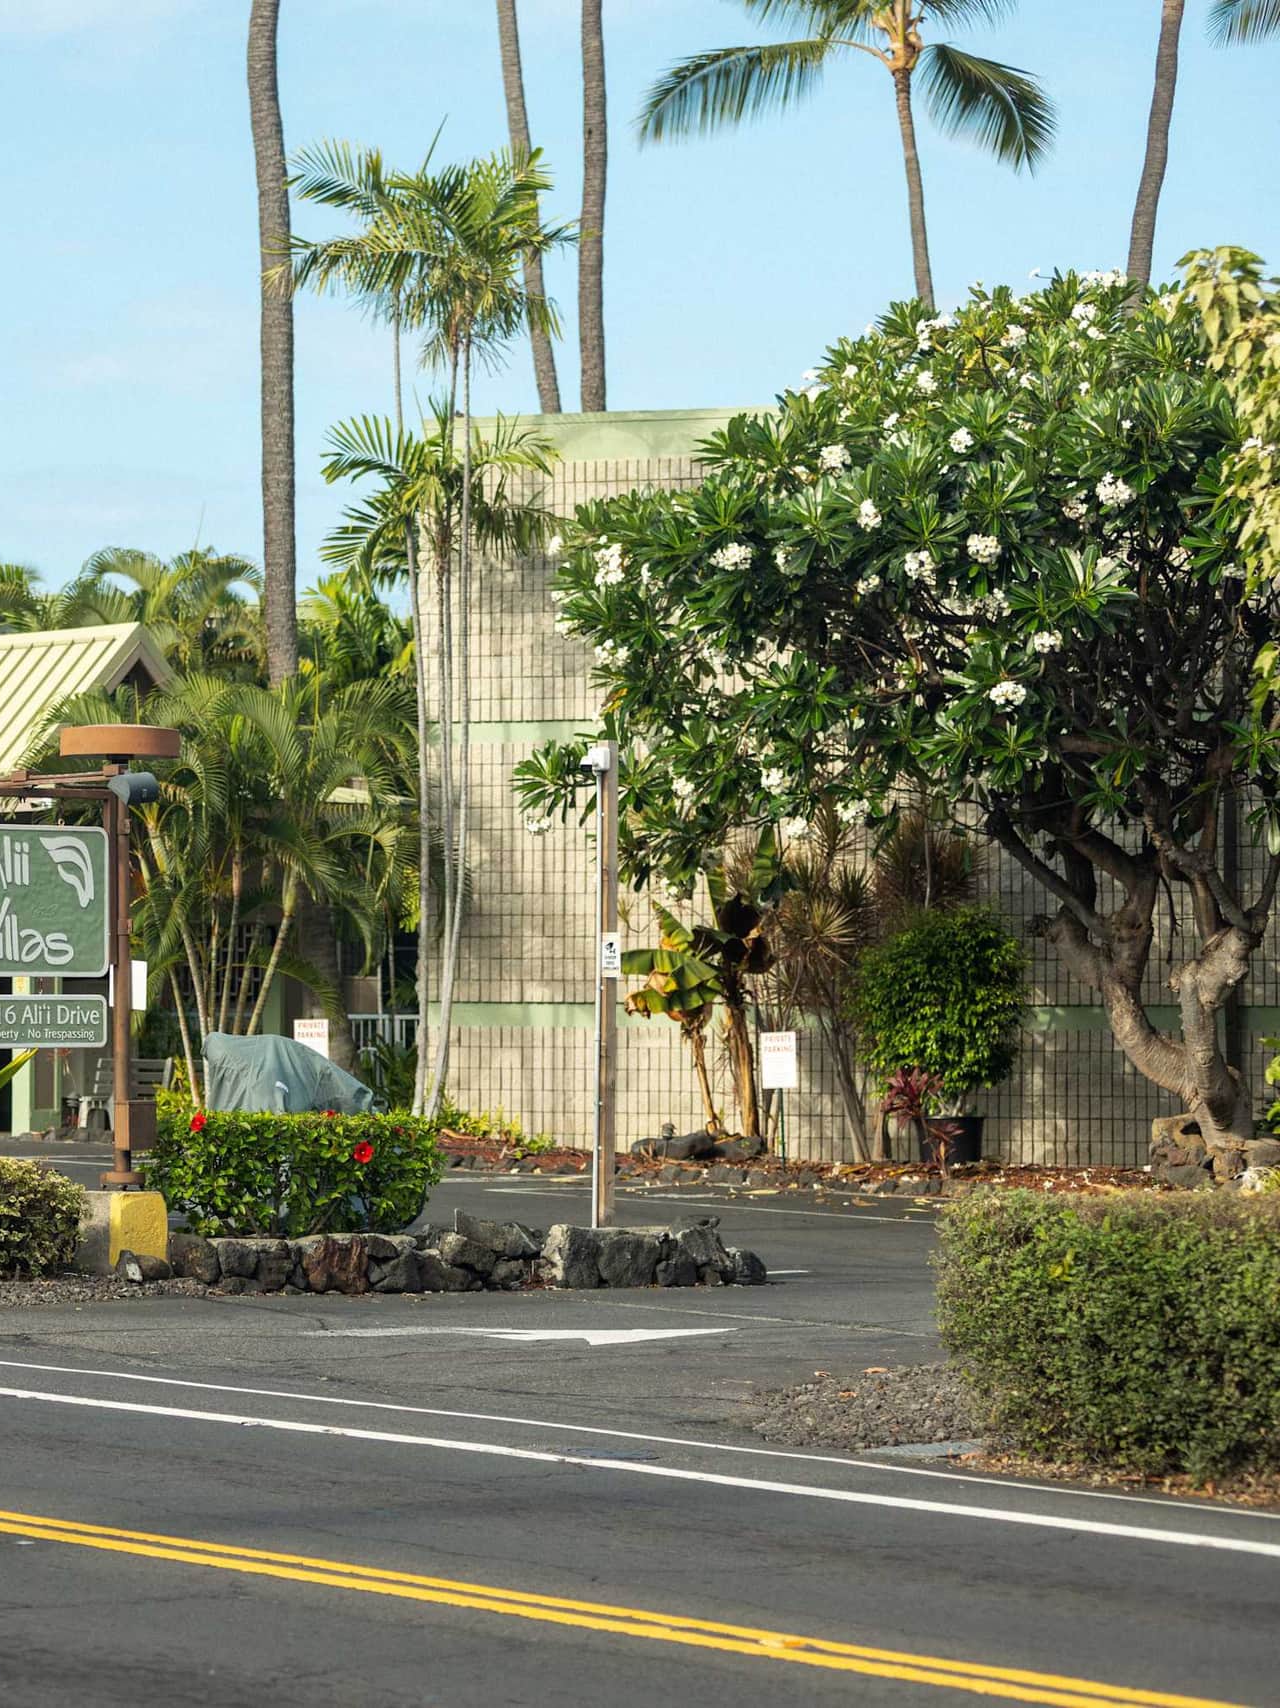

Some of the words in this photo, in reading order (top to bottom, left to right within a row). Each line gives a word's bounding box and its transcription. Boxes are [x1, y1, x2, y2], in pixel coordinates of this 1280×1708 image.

[56, 1005, 100, 1025] Drive
[27, 1029, 41, 1039] No
[44, 1029, 95, 1041] Trespassing
